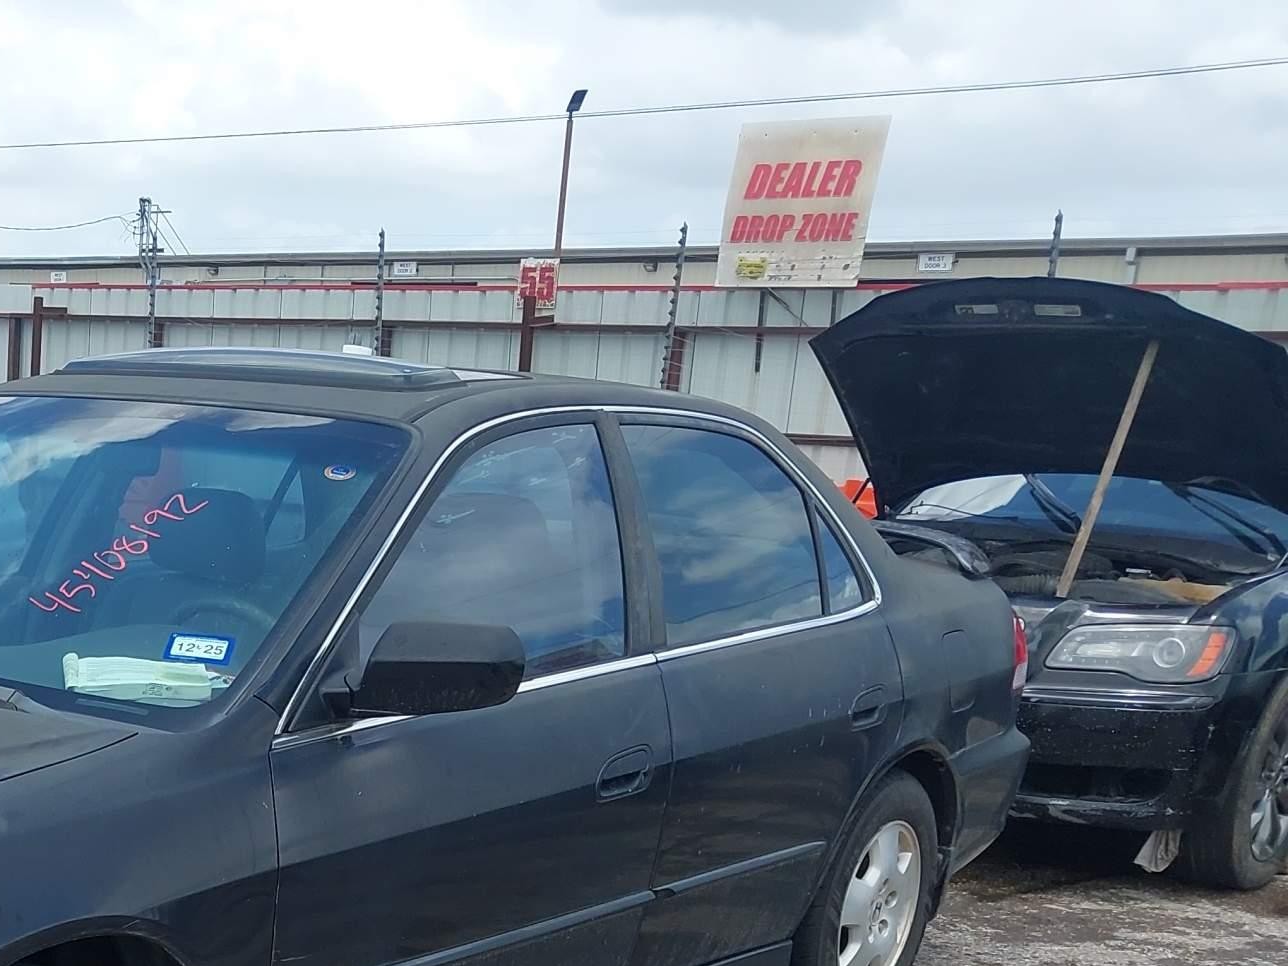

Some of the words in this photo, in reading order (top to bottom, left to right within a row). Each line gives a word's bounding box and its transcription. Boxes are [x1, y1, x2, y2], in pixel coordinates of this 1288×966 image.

[743, 159, 863, 201] DEALER
[729, 214, 796, 244] DROP
[793, 212, 860, 243] ZONE
[520, 266, 555, 301] 55
[29, 493, 209, 613] 45408192
